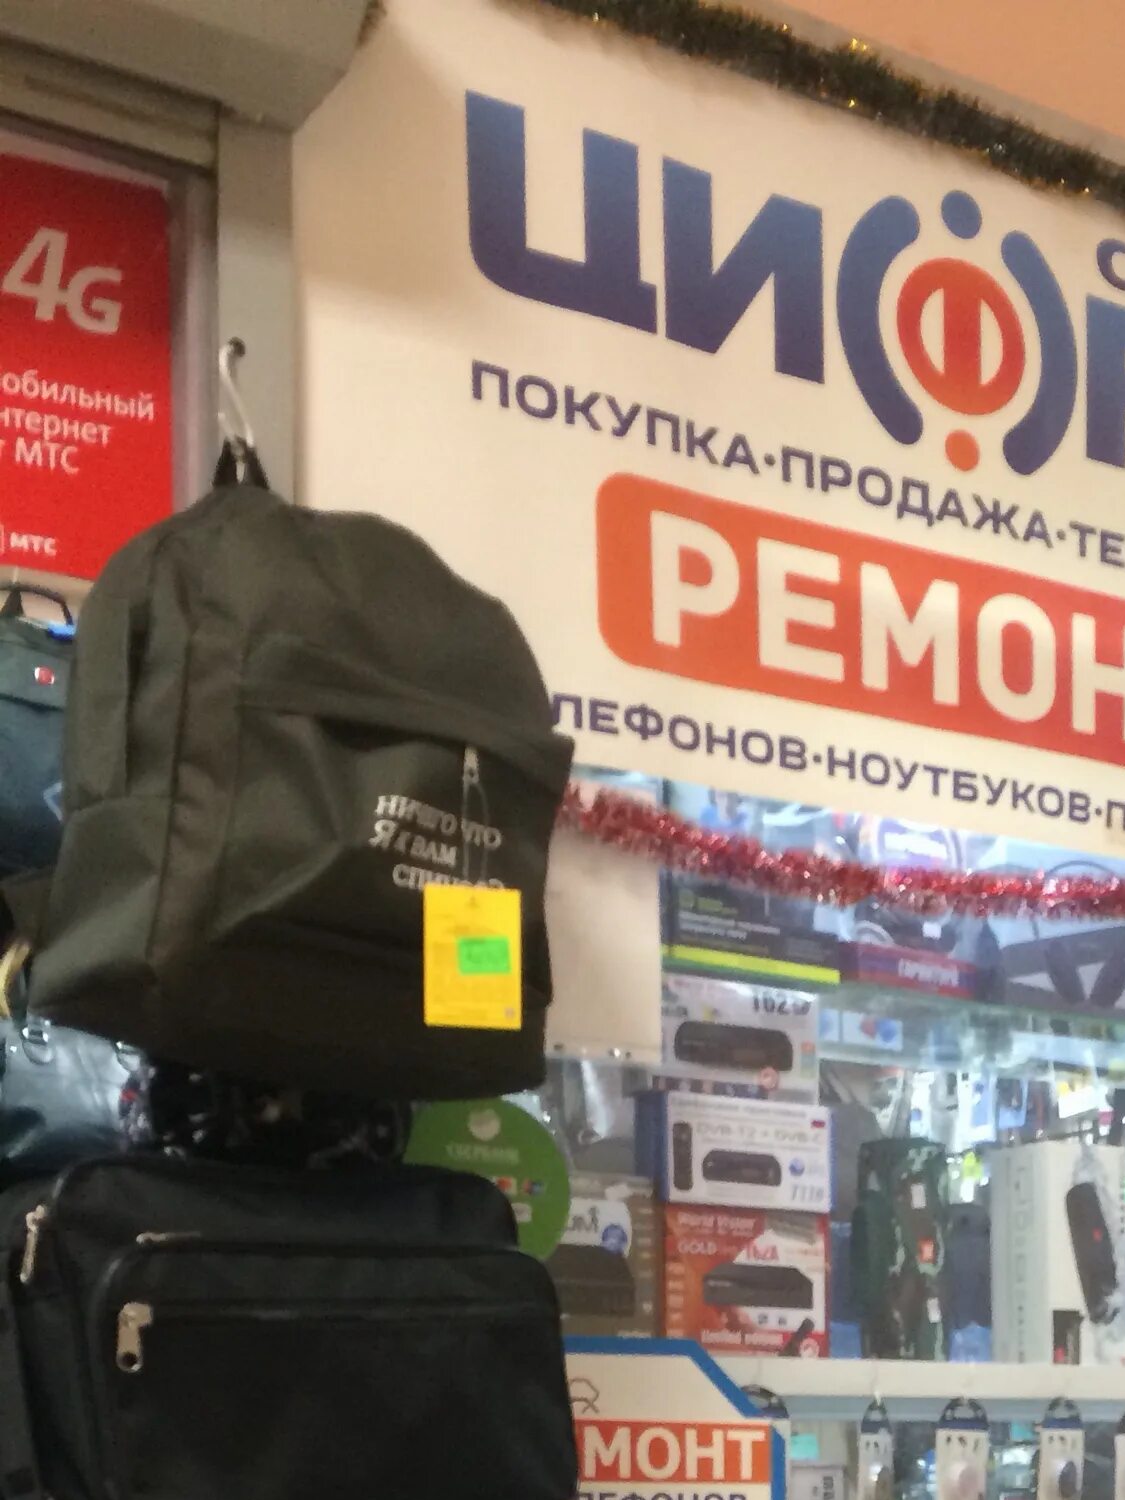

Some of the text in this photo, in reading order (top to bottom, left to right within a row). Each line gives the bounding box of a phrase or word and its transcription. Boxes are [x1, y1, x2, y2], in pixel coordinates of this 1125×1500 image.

[1, 227, 124, 335] 4G
[0, 369, 154, 421] обильный
[0, 406, 112, 447] нтернет
[15, 436, 80, 475] МТС
[553, 691, 807, 773] ЛЕФОНОВ
[582, 1425, 766, 1481] МОНТ
